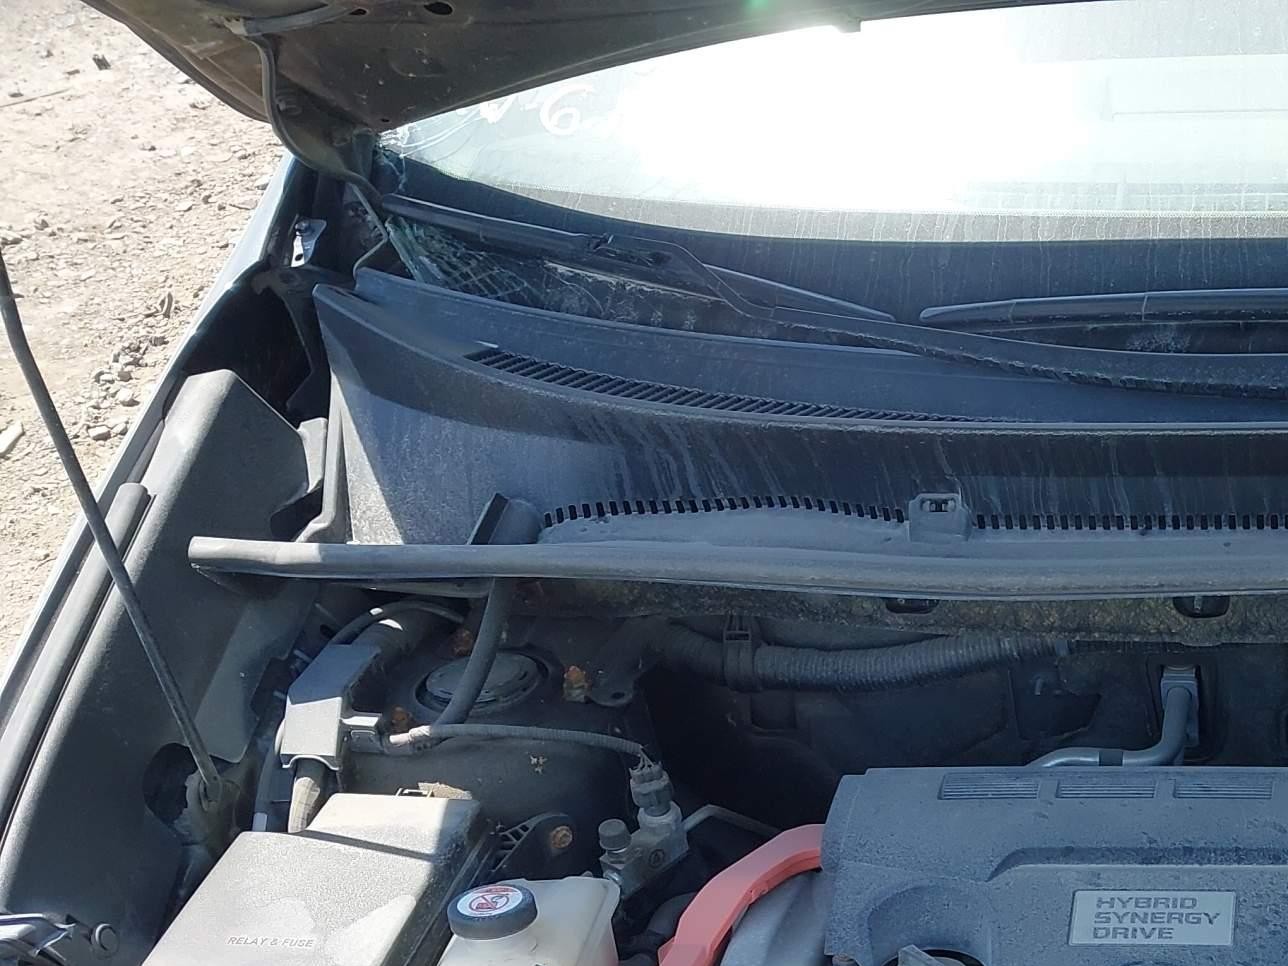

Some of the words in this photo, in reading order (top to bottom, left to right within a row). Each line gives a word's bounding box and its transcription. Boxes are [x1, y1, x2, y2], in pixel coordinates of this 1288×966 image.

[1095, 896, 1198, 909] HYBRID
[1093, 911, 1221, 925] SYNERGY
[1092, 926, 1175, 939] DRIVE
[227, 936, 268, 946] RELAY
[281, 937, 315, 948] FUSE
